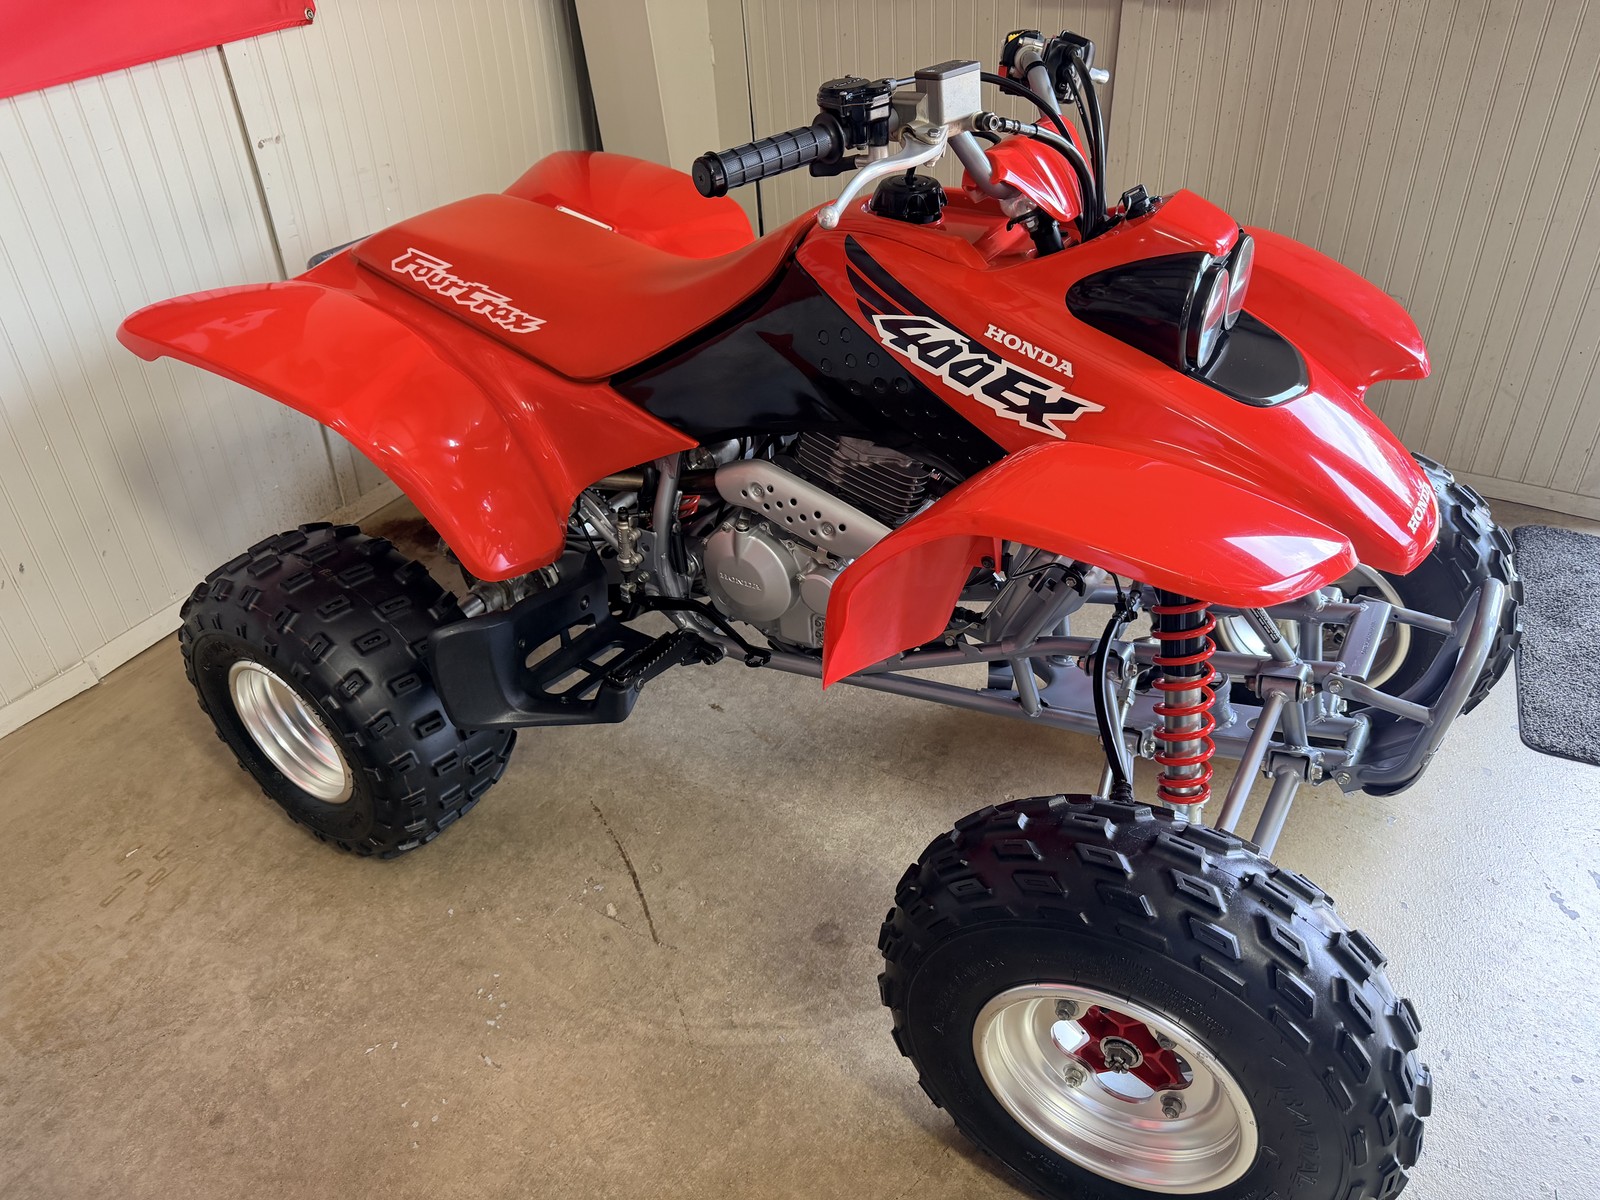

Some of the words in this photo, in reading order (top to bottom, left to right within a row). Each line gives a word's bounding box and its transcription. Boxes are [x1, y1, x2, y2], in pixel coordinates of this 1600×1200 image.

[391, 247, 548, 333] FourTrax
[872, 314, 1106, 440] 400EX
[983, 323, 1075, 378] HONDA
[719, 572, 762, 592] HONDA
